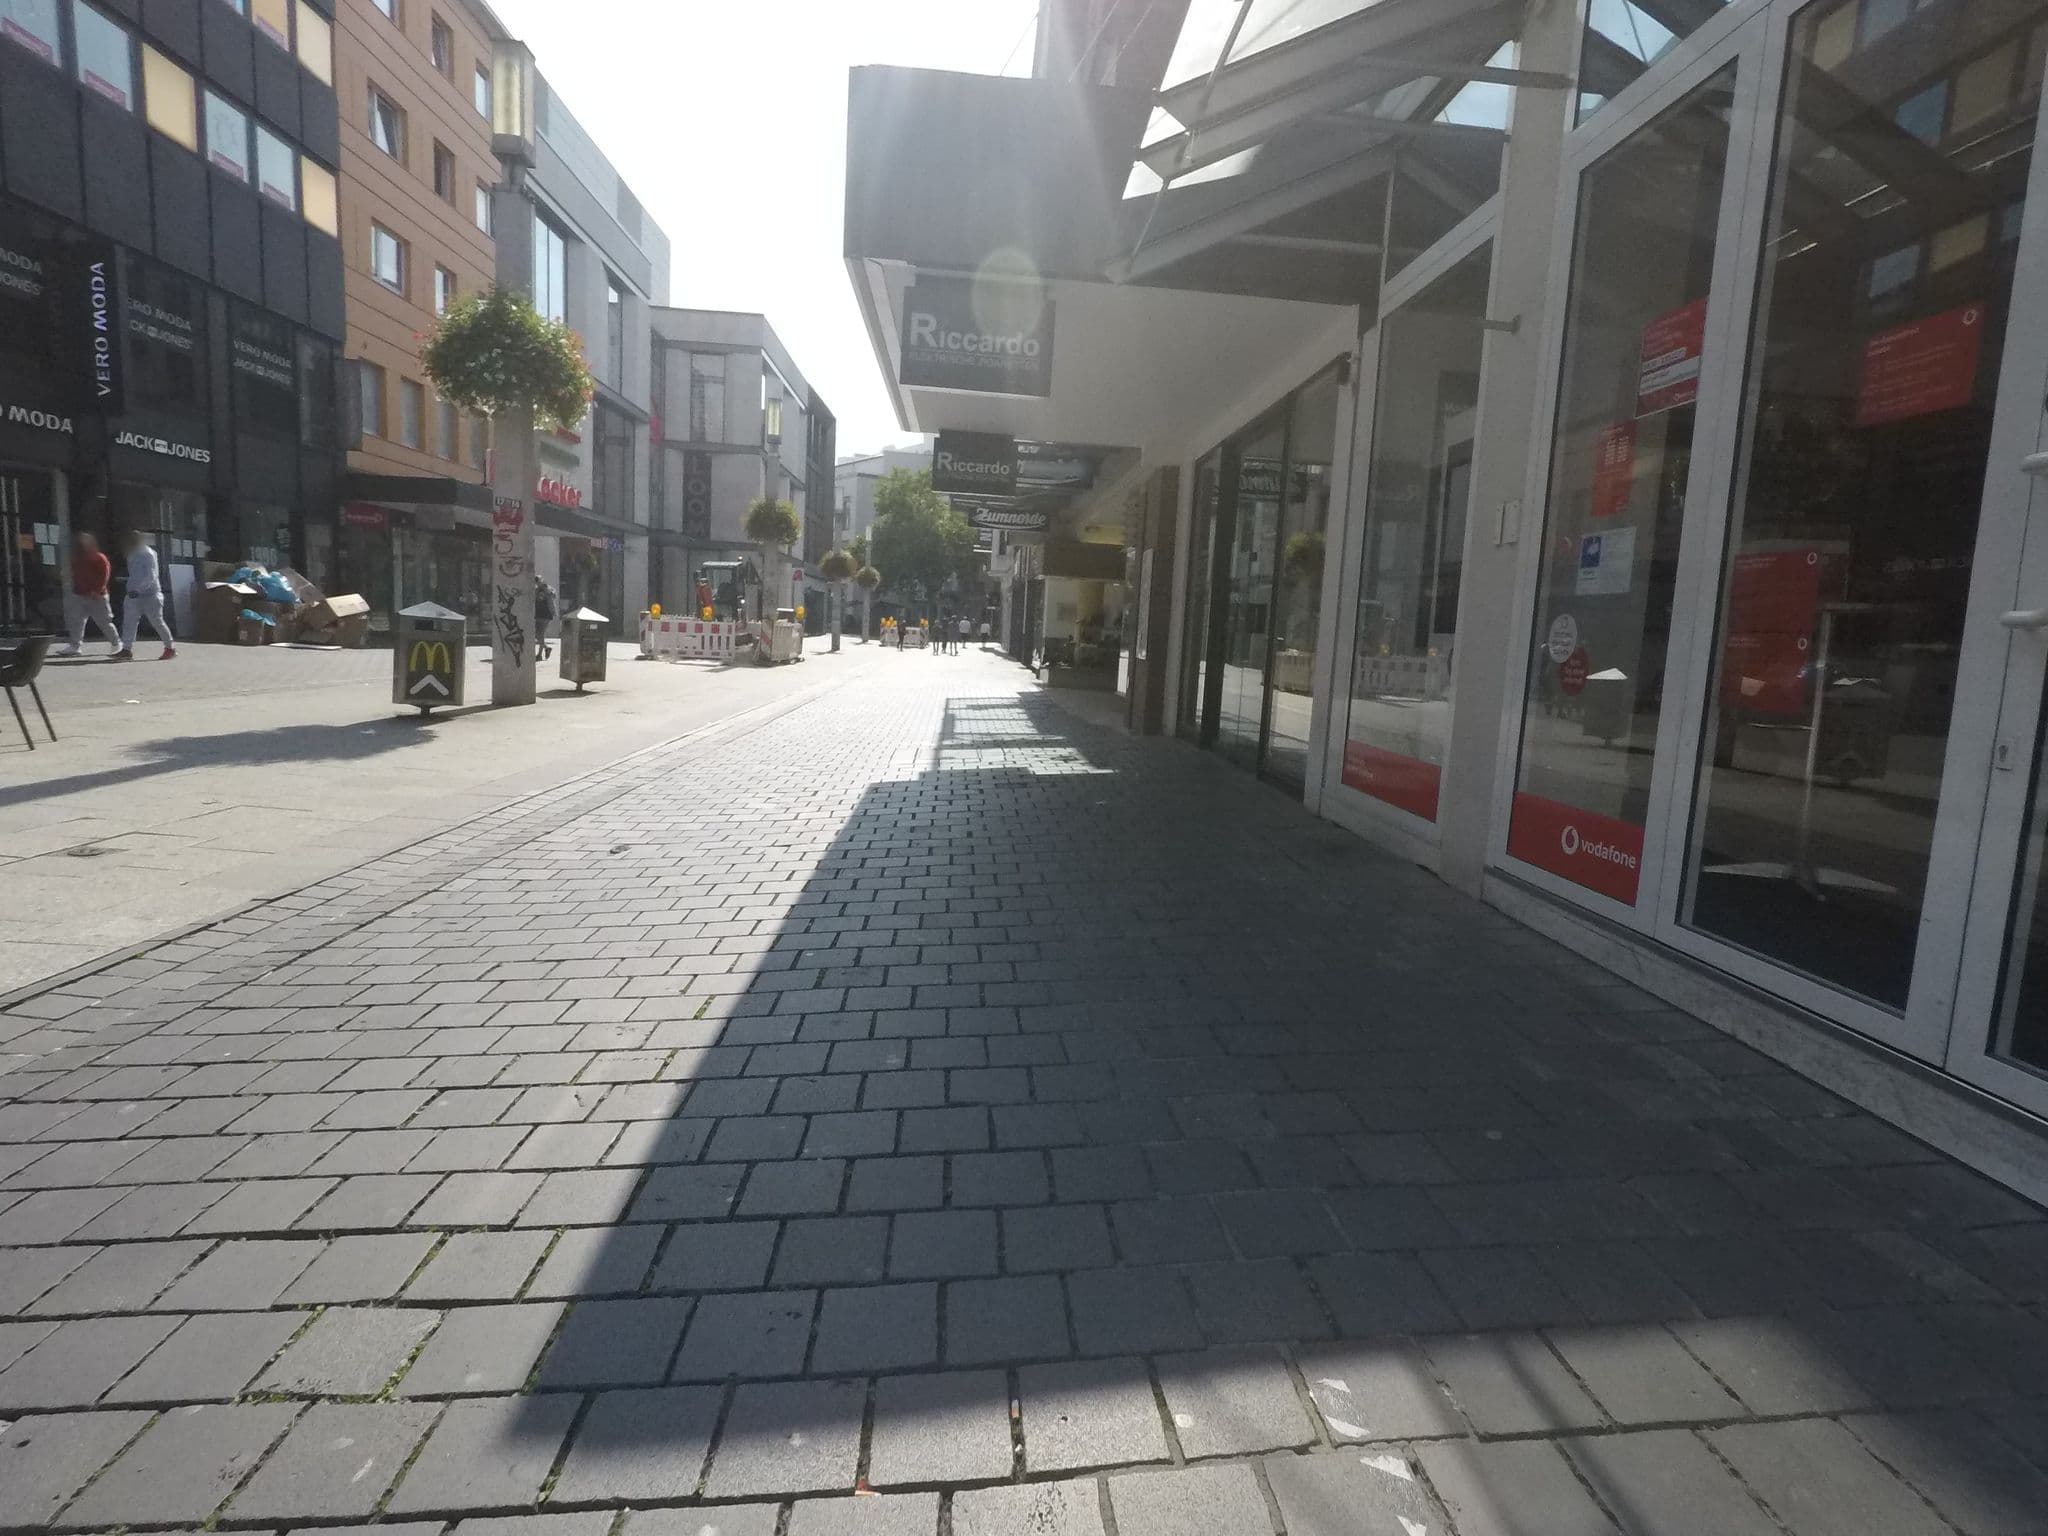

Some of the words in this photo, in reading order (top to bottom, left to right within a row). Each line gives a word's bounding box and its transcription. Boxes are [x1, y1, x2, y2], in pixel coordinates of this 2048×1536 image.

[90, 262, 108, 331] MODA
[911, 311, 1041, 357] Riccardo
[94, 336, 112, 396] VERO
[8, 404, 74, 434] MODA
[937, 451, 1009, 475] Riccardo
[1581, 838, 1637, 870] vodafone
